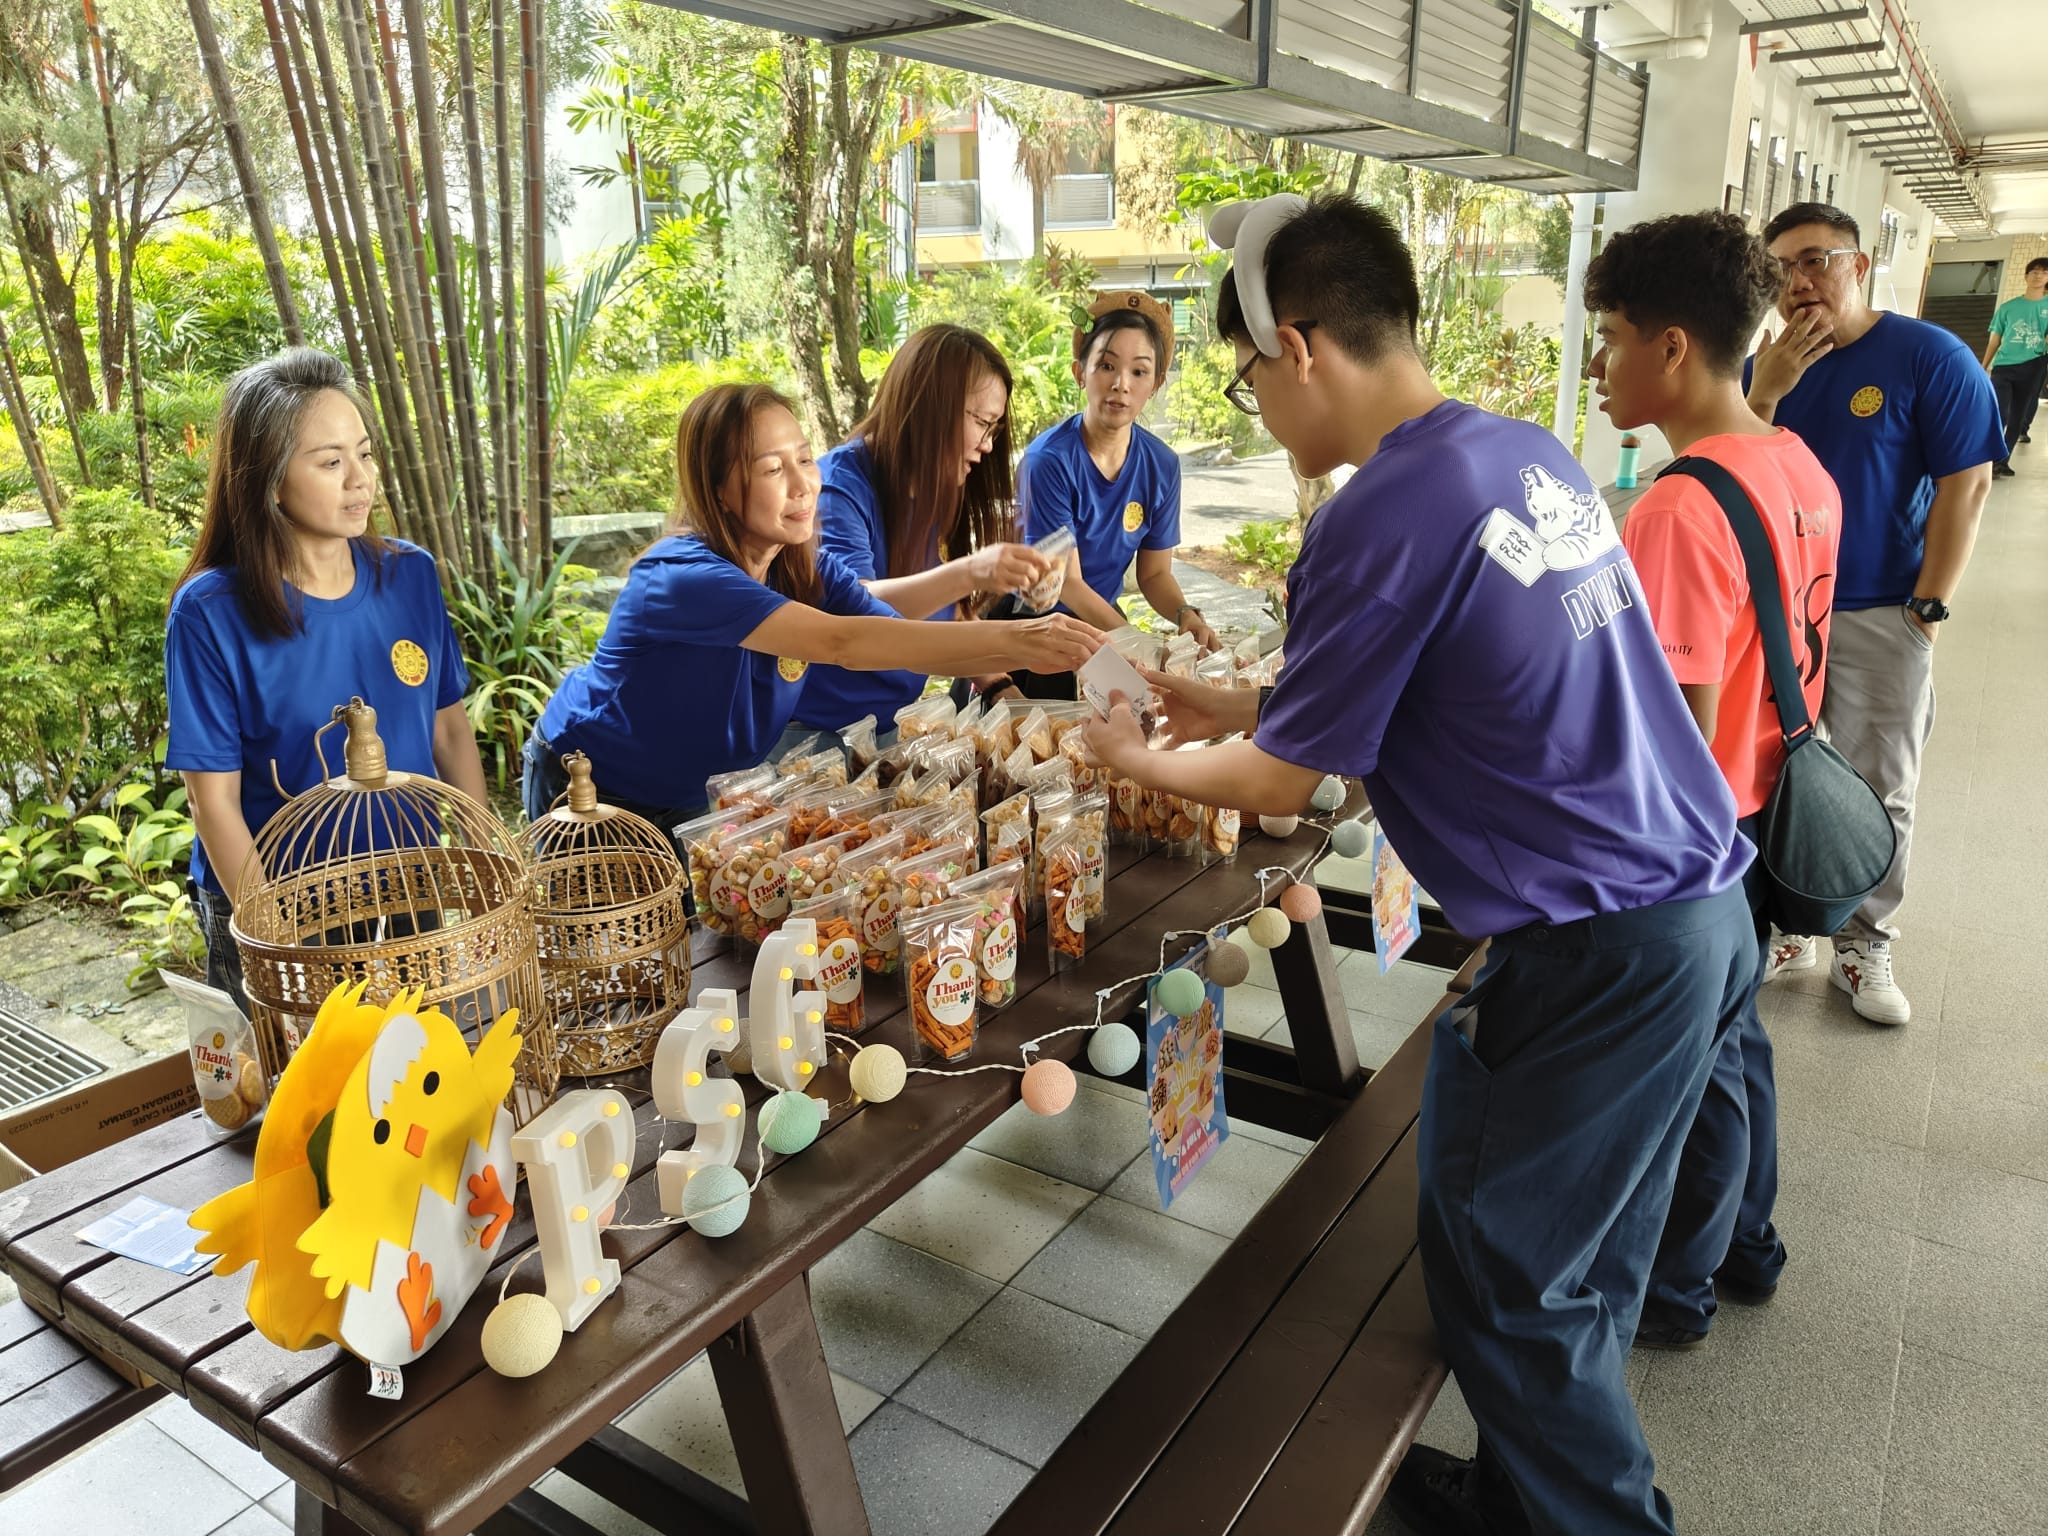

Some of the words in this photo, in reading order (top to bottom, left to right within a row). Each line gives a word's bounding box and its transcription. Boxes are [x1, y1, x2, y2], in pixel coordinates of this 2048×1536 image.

[751, 872, 788, 899] Thank
[756, 890, 777, 910] you
[870, 924, 894, 943] you
[987, 931, 1016, 959] Thank
[818, 951, 859, 981] Thank
[988, 952, 1008, 970] you
[821, 972, 848, 992] you
[931, 975, 976, 998] Thank
[931, 994, 959, 1009] you
[194, 1044, 234, 1068] Thank
[194, 1059, 215, 1075] you
[141, 1088, 184, 1112] DENGAN
[98, 1106, 141, 1130] CERMAT
[132, 1109, 161, 1128] CARE
